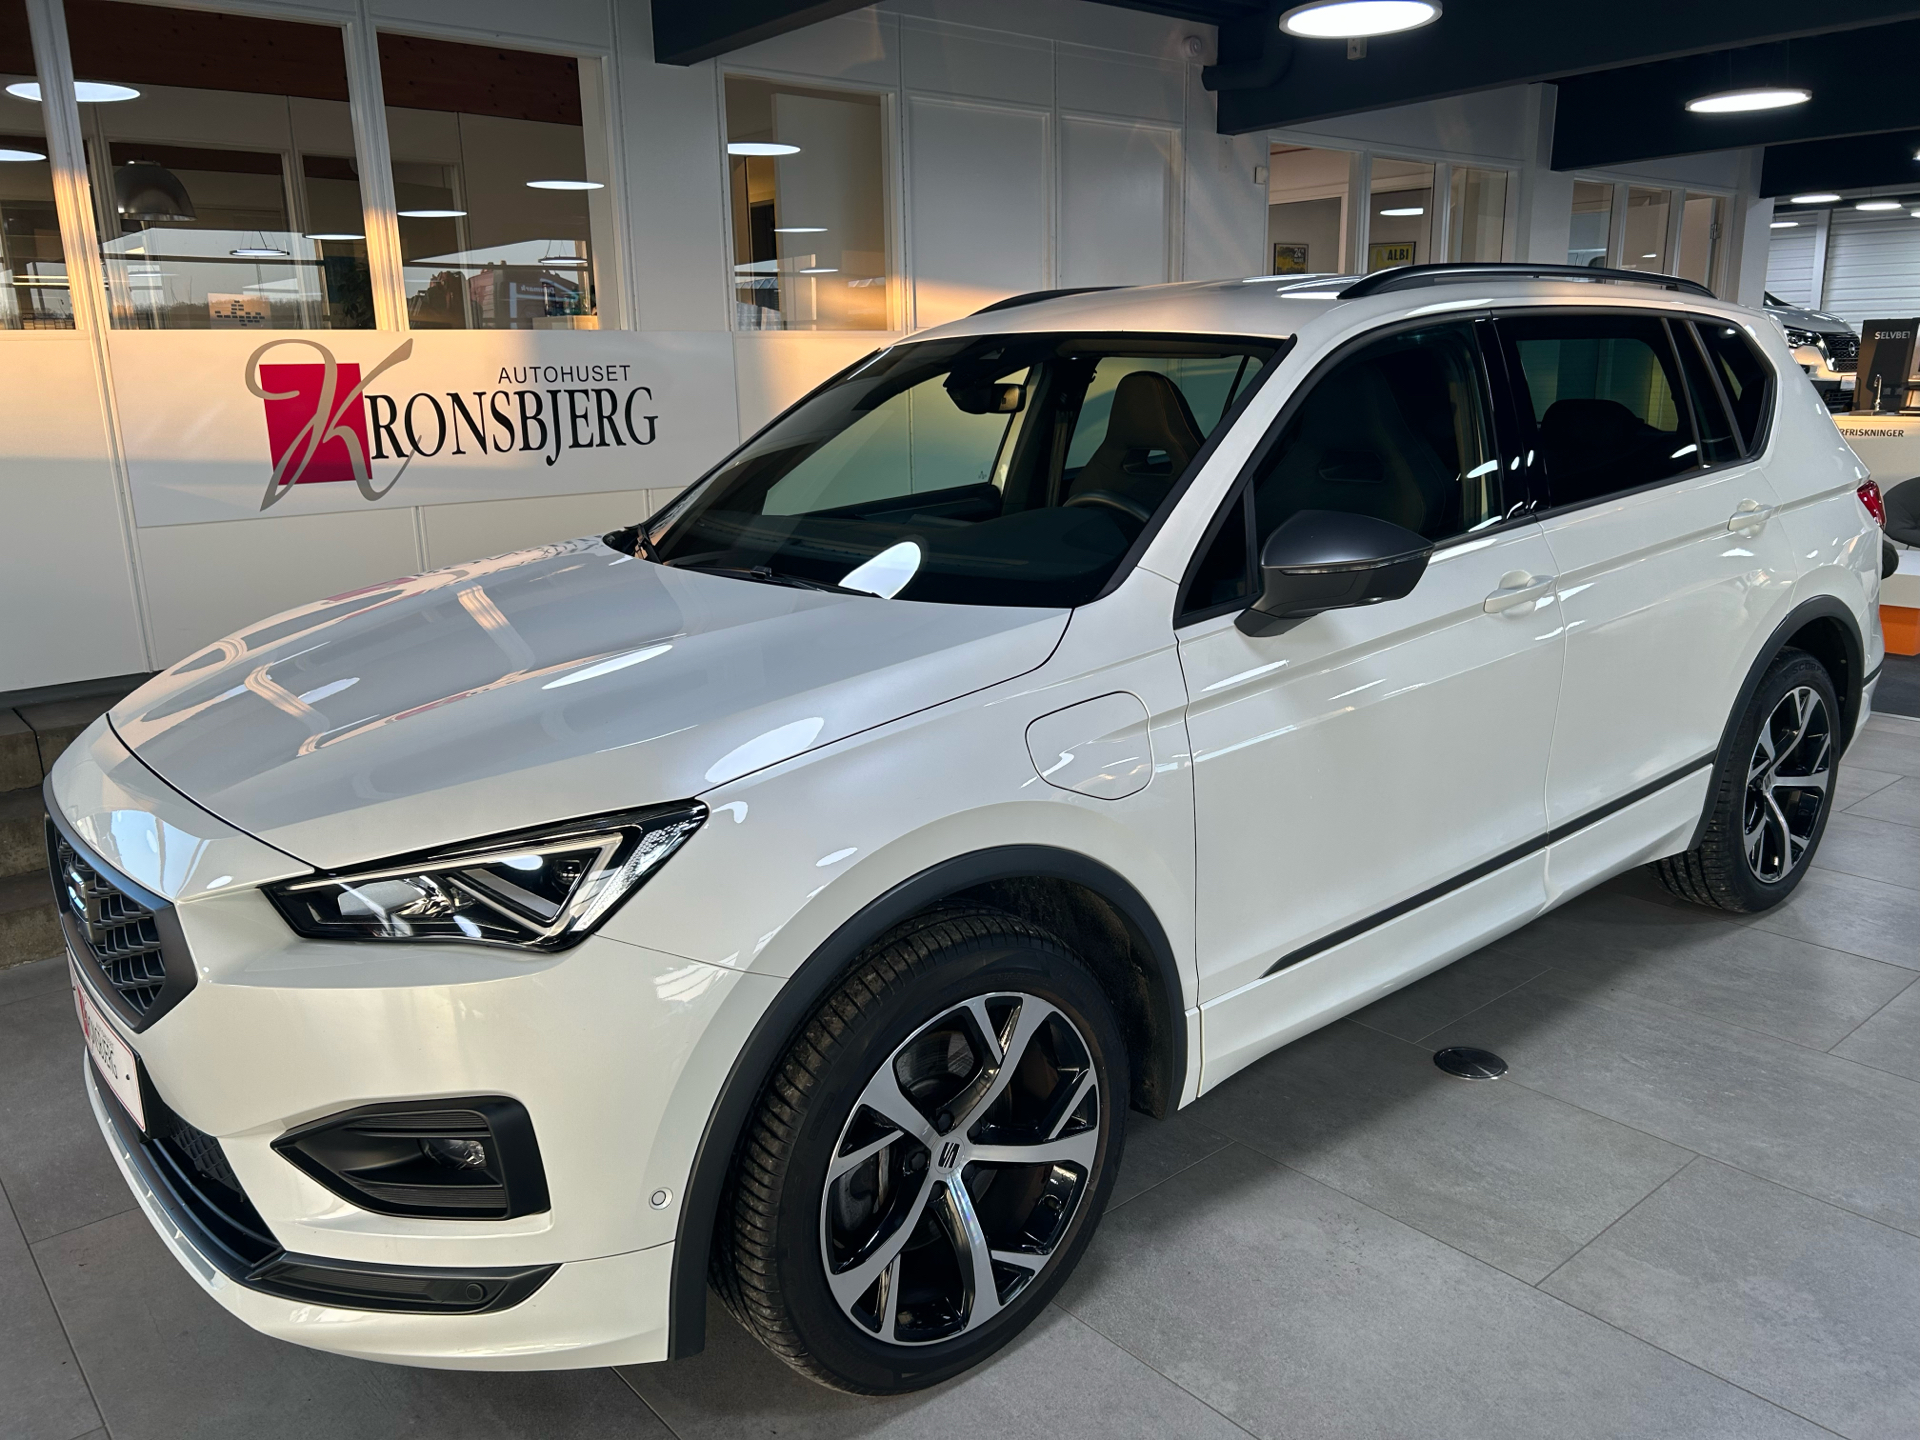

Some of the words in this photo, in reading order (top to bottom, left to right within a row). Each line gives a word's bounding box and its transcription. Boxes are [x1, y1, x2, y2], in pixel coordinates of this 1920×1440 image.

[1387, 248, 1409, 261] ALBI
[498, 364, 631, 384] AUTOHUSET
[245, 338, 658, 511] KRONSBJERG
